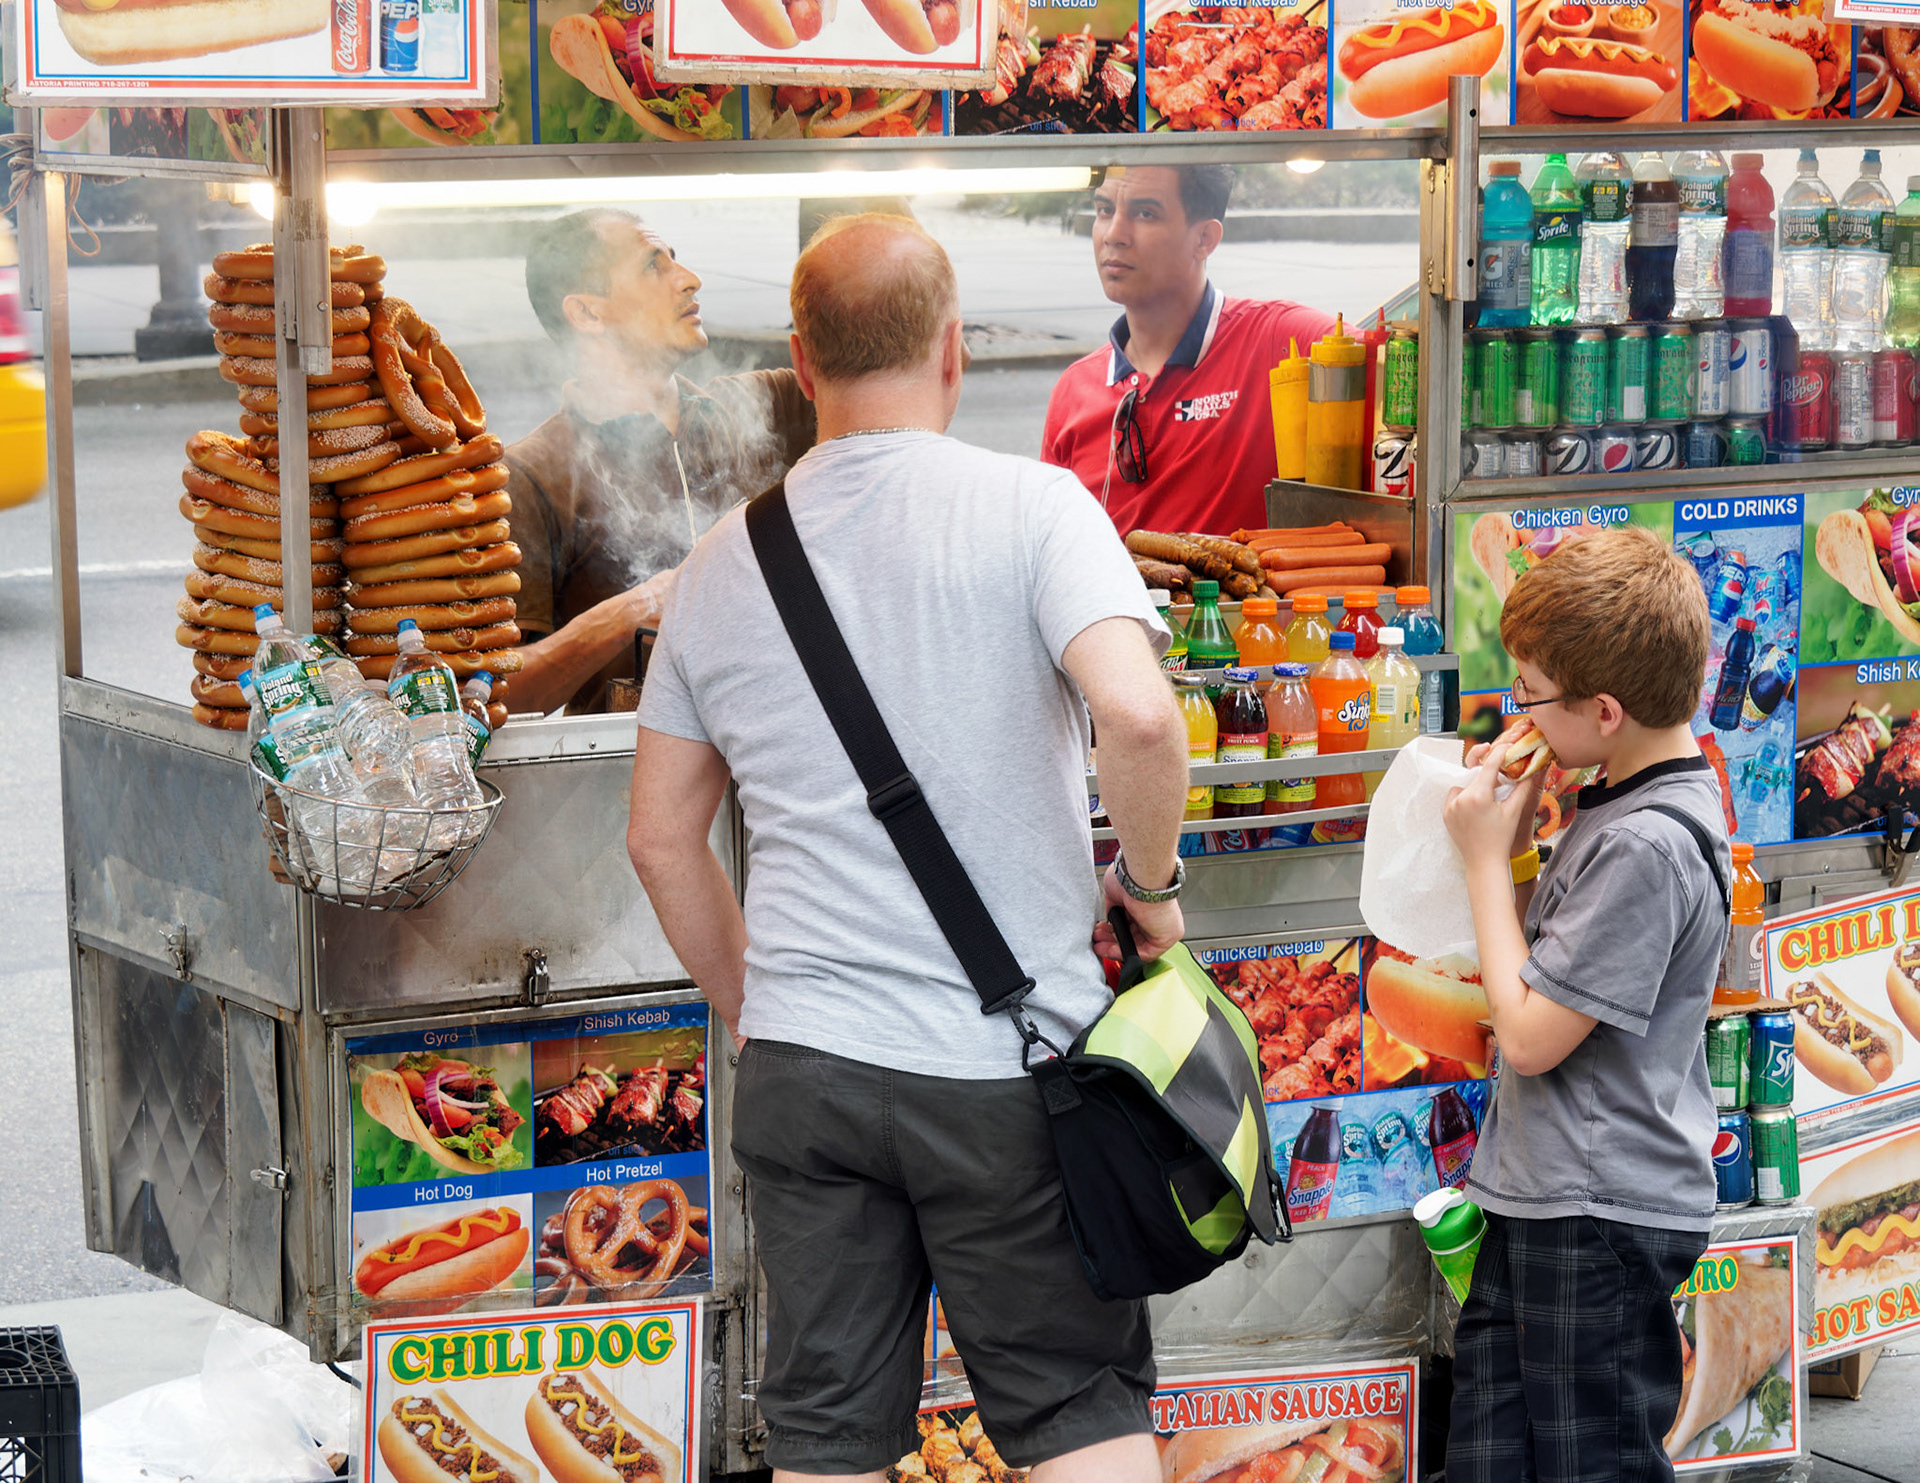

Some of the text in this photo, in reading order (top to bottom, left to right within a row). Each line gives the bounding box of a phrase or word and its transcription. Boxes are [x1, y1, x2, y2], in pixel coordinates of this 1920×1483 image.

[29, 80, 61, 88] ASTORIA
[64, 80, 99, 88] PRINTING
[1679, 189, 1717, 205] Spring
[1537, 222, 1569, 241] Sprite
[1783, 222, 1820, 239] Spring
[1837, 223, 1873, 240] Spring
[1783, 379, 1820, 402] Pepper
[1792, 376, 1809, 388] Dr
[1194, 390, 1238, 406] NORTH
[1194, 399, 1231, 412] SAILS
[1194, 408, 1220, 421] USA
[1512, 504, 1629, 529] Chicken Gyro
[1681, 497, 1798, 521] COLD DRINKS
[260, 671, 293, 691] Poland
[1856, 658, 1920, 684] Shish K
[262, 681, 304, 710] Spring
[1778, 905, 1896, 973] CHILI
[1202, 940, 1324, 964] Chicken Kebab
[584, 1008, 671, 1031] Shish Kebab
[424, 1031, 459, 1046] Gyro
[586, 1161, 663, 1182] Hot Pretzel
[1307, 1164, 1326, 1172] PEACH
[1442, 1149, 1475, 1188] Snapp
[414, 1183, 474, 1202] Hot Dog
[1288, 1178, 1333, 1207] Snapple
[1294, 1206, 1320, 1216] ICED TEA
[1805, 1294, 1873, 1349] HOT
[388, 1316, 677, 1385] CHILI DOG
[1268, 1377, 1402, 1424] SAUSAGE
